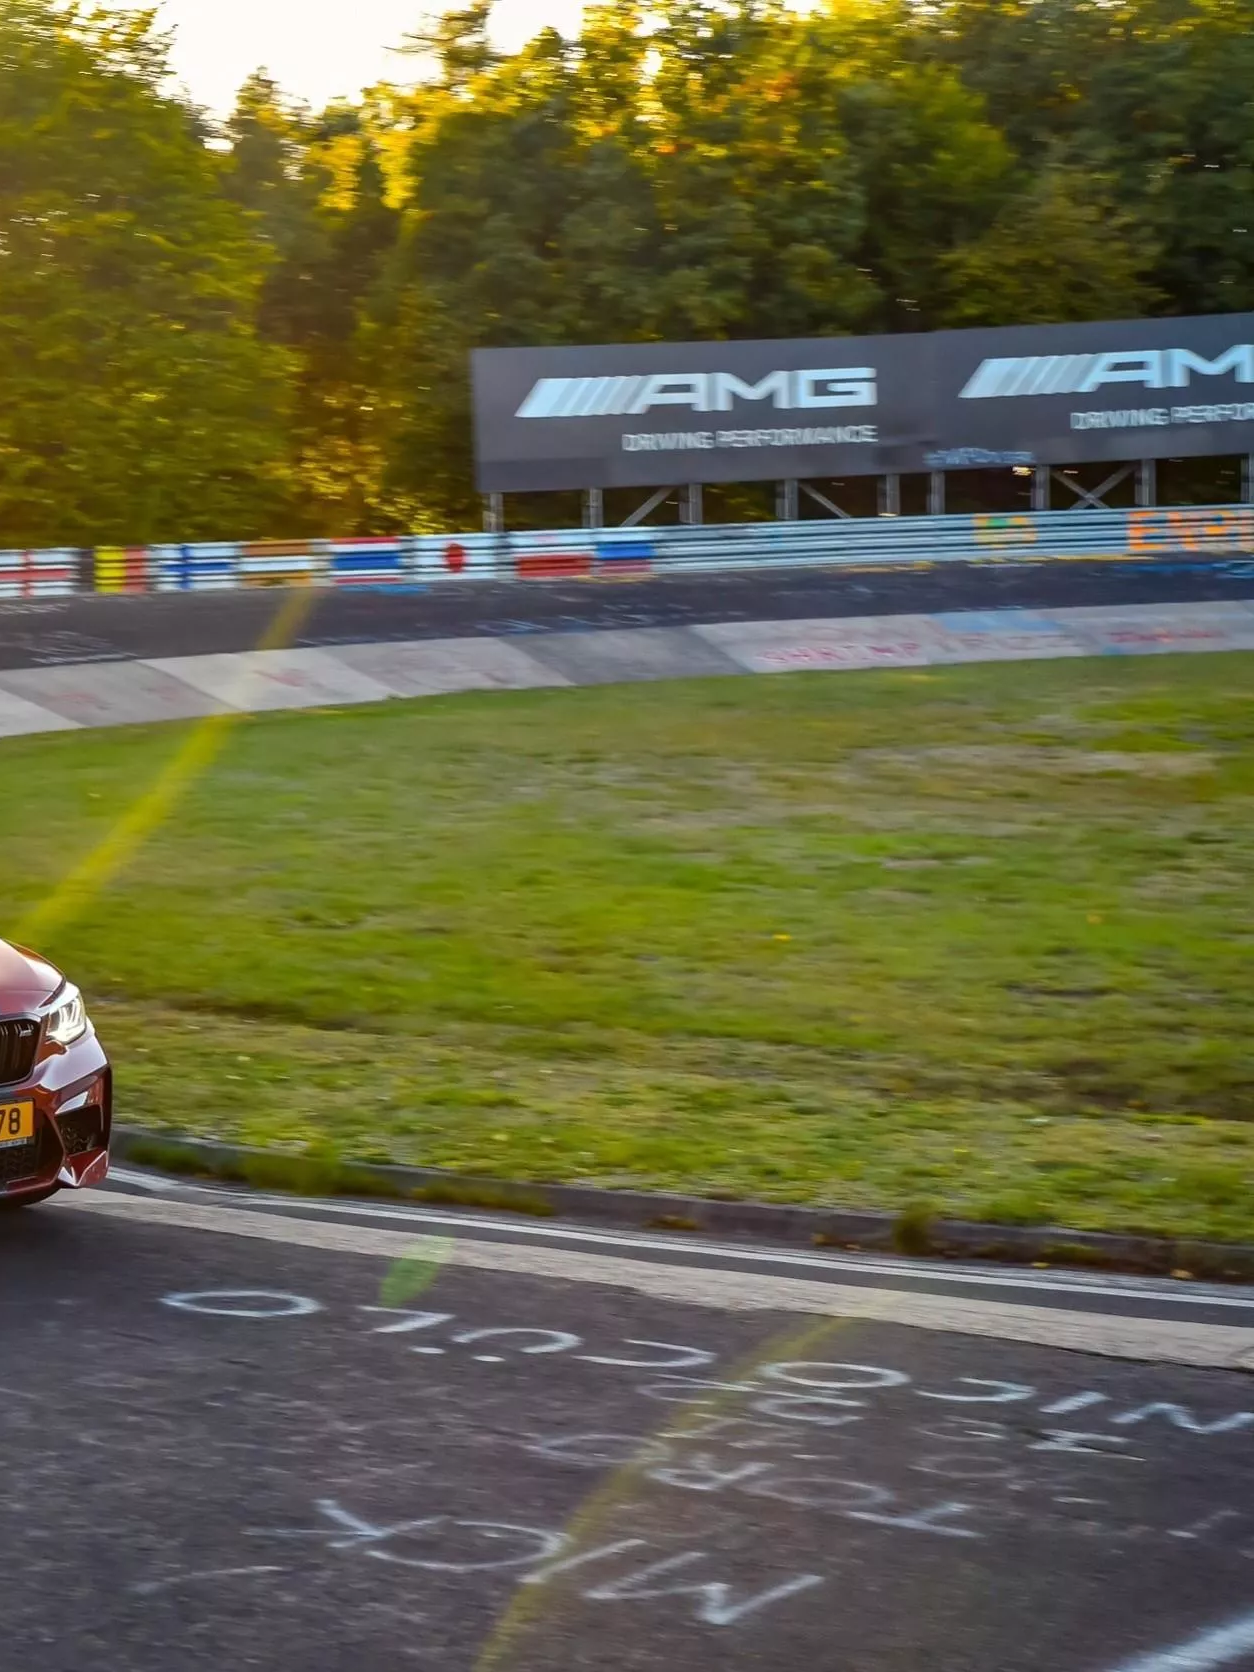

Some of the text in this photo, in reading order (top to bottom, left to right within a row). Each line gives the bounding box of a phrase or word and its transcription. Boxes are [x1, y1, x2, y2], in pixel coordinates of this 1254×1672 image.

[627, 367, 877, 414] AMG
[1070, 407, 1170, 430] DRIVING
[622, 425, 878, 451] DRIVING PERFORMANCE
